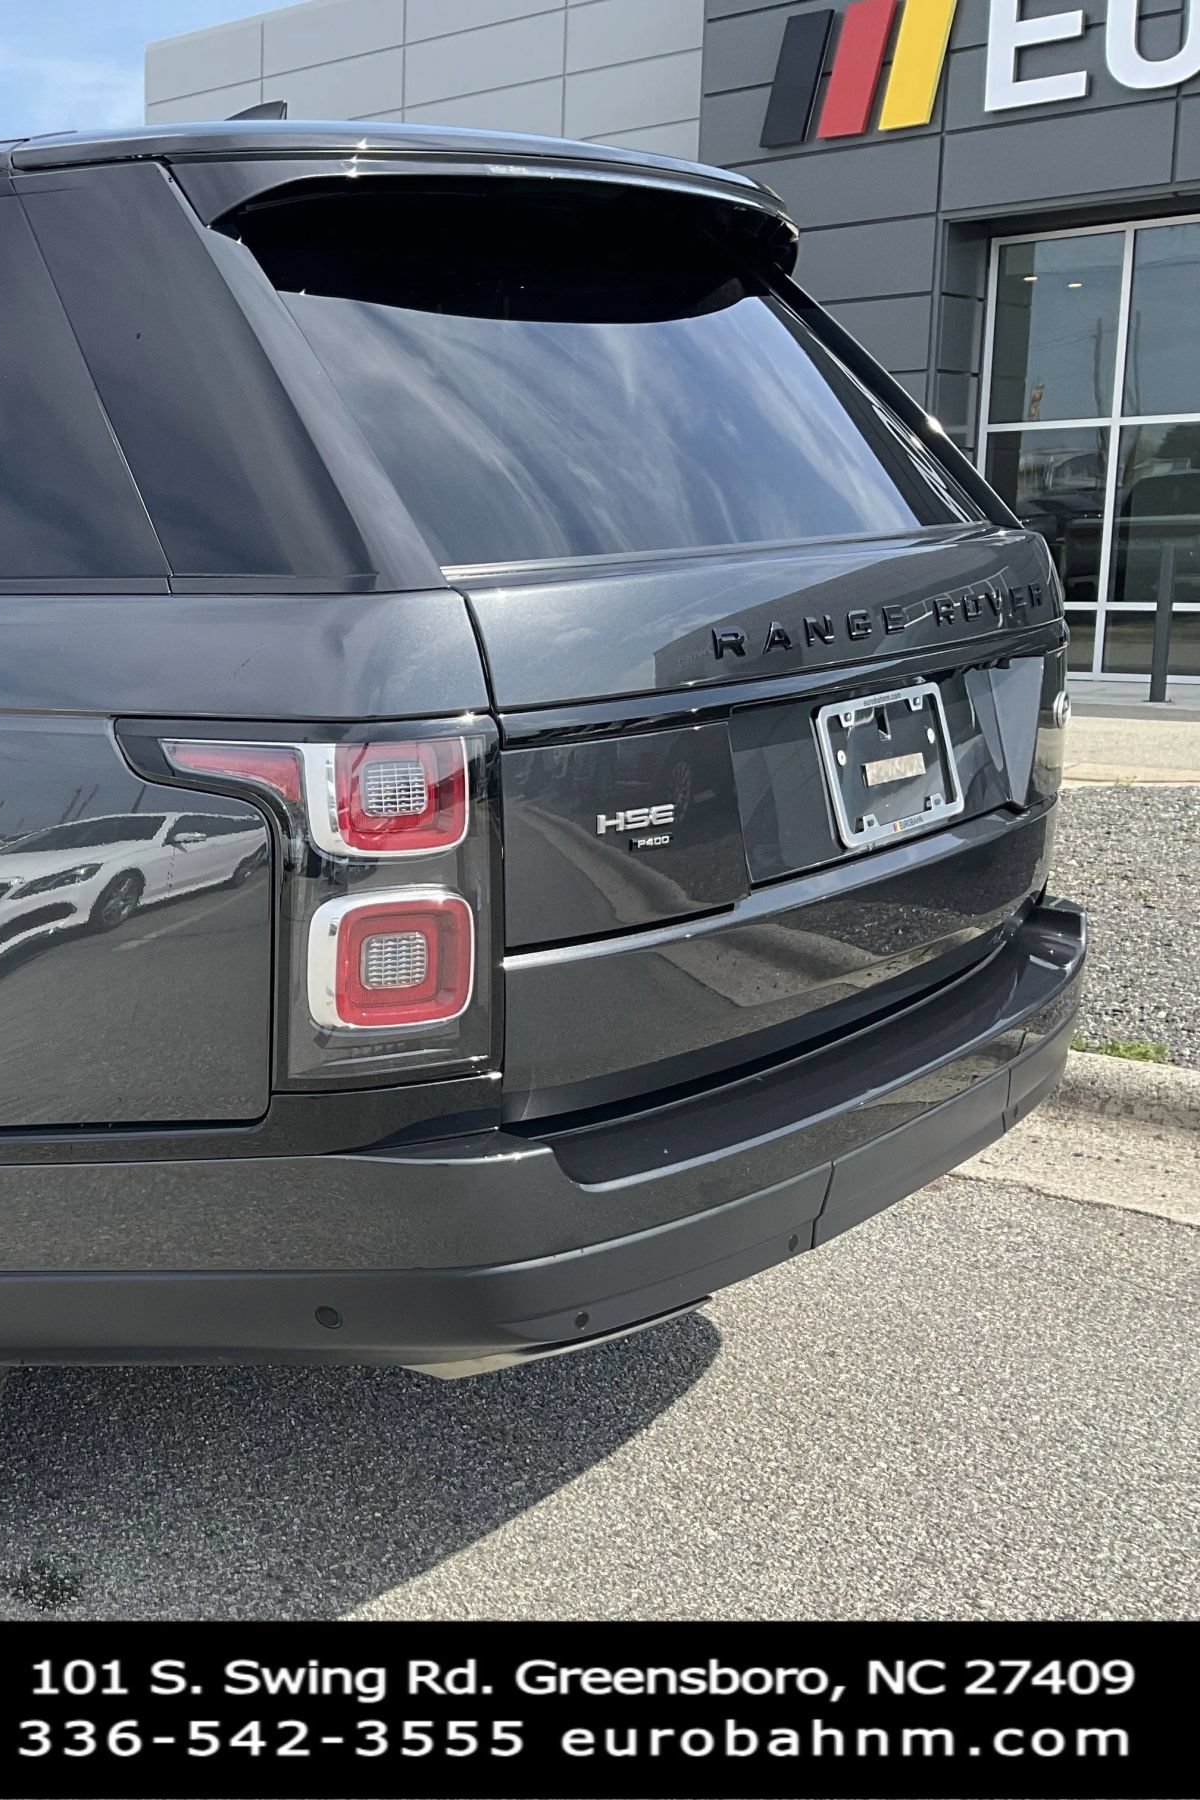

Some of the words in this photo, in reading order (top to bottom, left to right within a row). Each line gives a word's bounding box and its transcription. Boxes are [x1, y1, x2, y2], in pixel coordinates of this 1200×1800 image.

[711, 604, 907, 660] RANGE
[932, 582, 1042, 627] ROVER
[596, 803, 675, 835] HSE
[637, 835, 670, 849] P400
